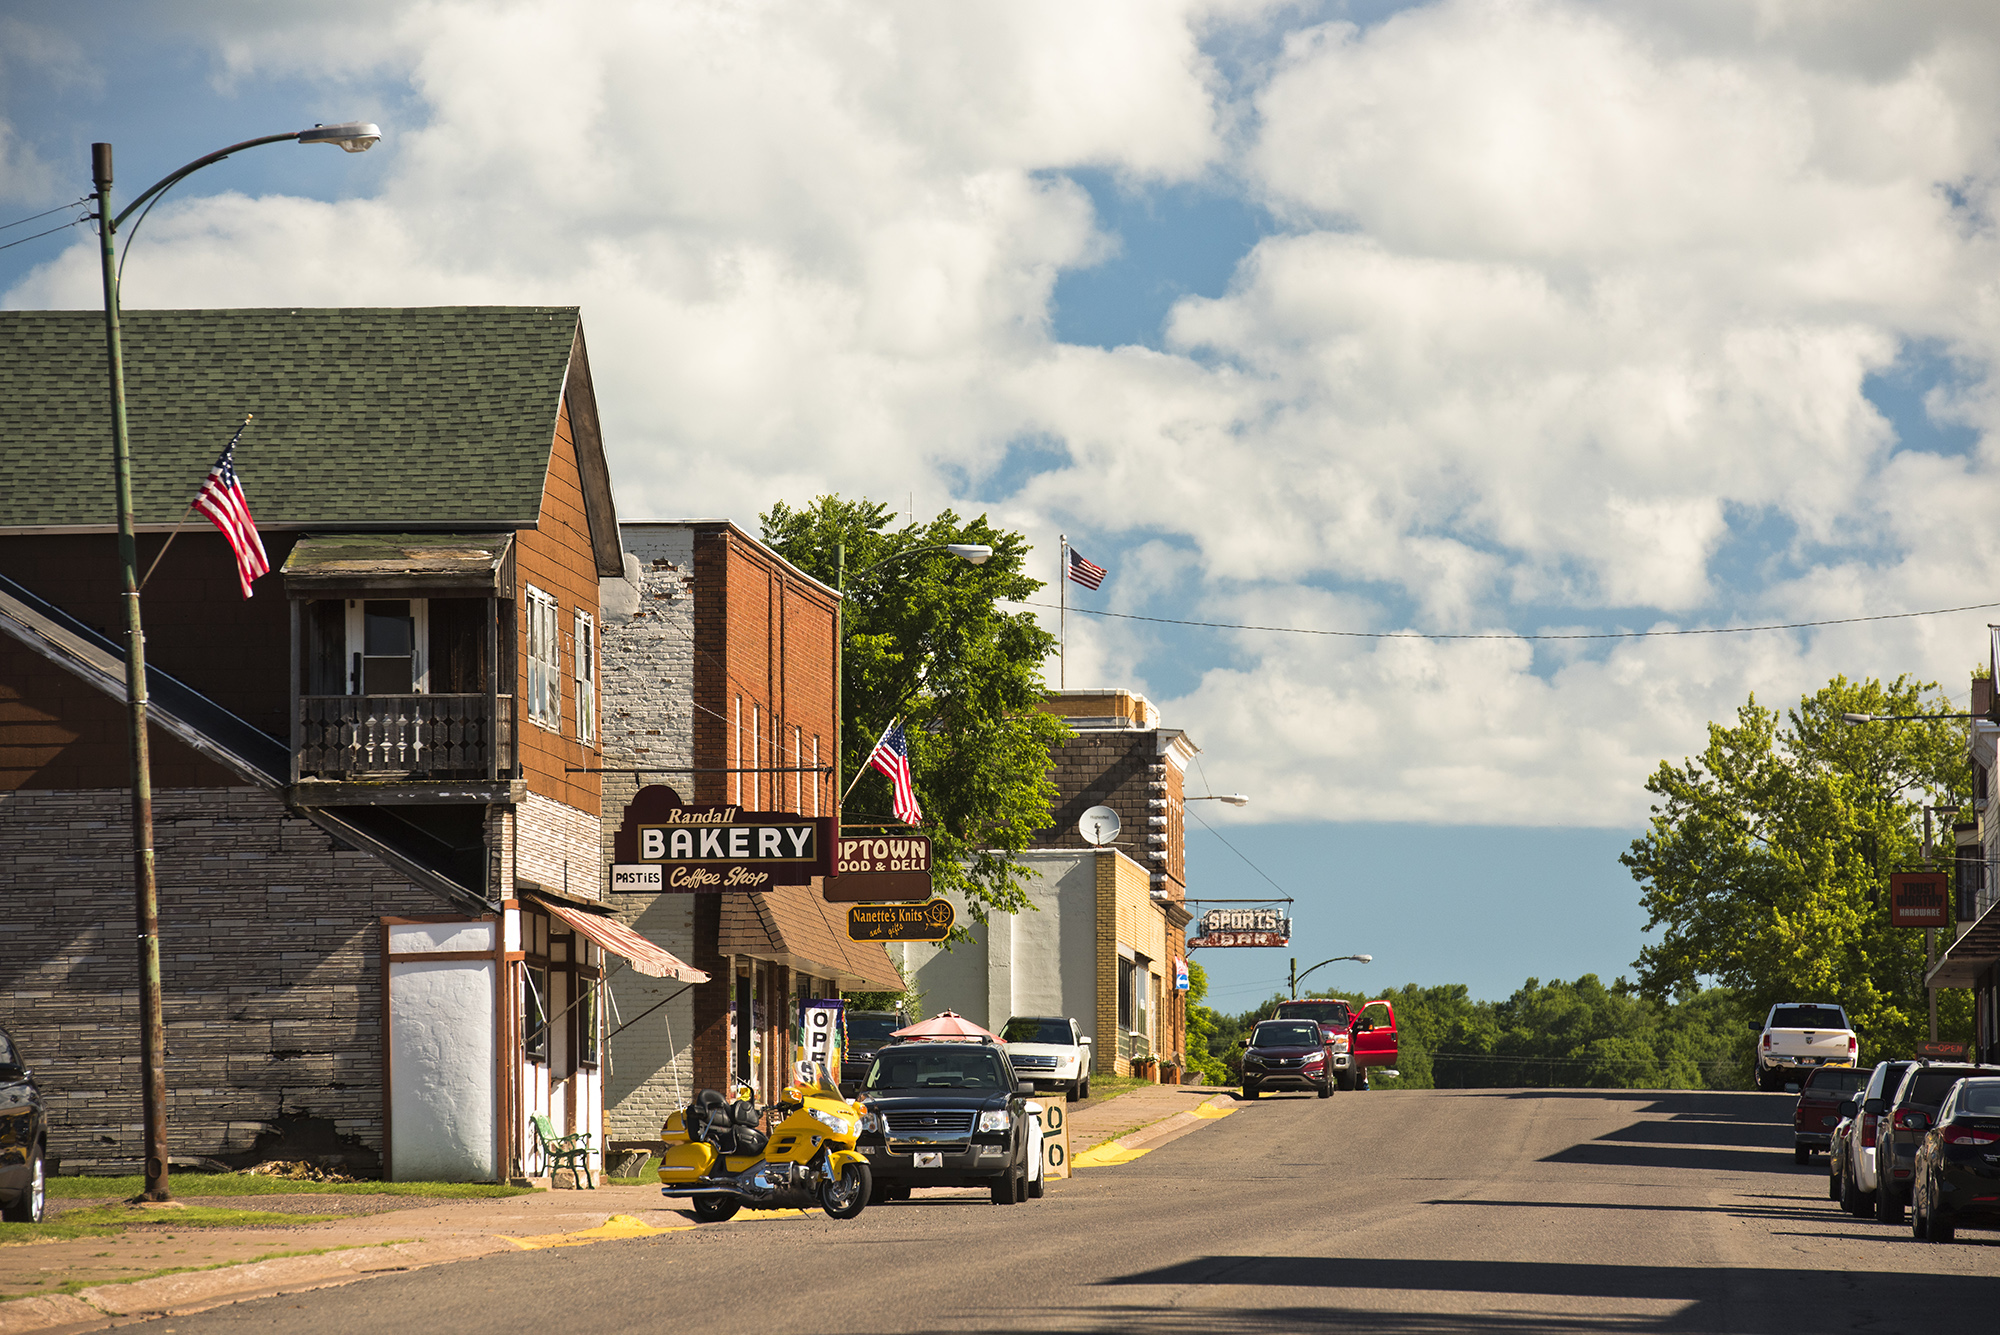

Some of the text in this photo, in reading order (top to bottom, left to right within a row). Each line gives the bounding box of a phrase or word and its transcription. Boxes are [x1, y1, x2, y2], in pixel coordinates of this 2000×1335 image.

[666, 807, 736, 824] Randall
[643, 827, 812, 859] BAKERY
[838, 859, 925, 872] OOD & DELI
[669, 866, 769, 888] Coffee Shop
[1902, 883, 1936, 895] TRUST
[1896, 895, 1943, 907] WORTHY
[853, 908, 923, 922] Nanette's Knits
[1899, 908, 1941, 917] HARDWARE
[1208, 912, 1277, 930] SPORTS
[869, 923, 904, 938] and gifts
[1220, 933, 1268, 945] BAR
[1938, 1043, 1963, 1053] OPEN
